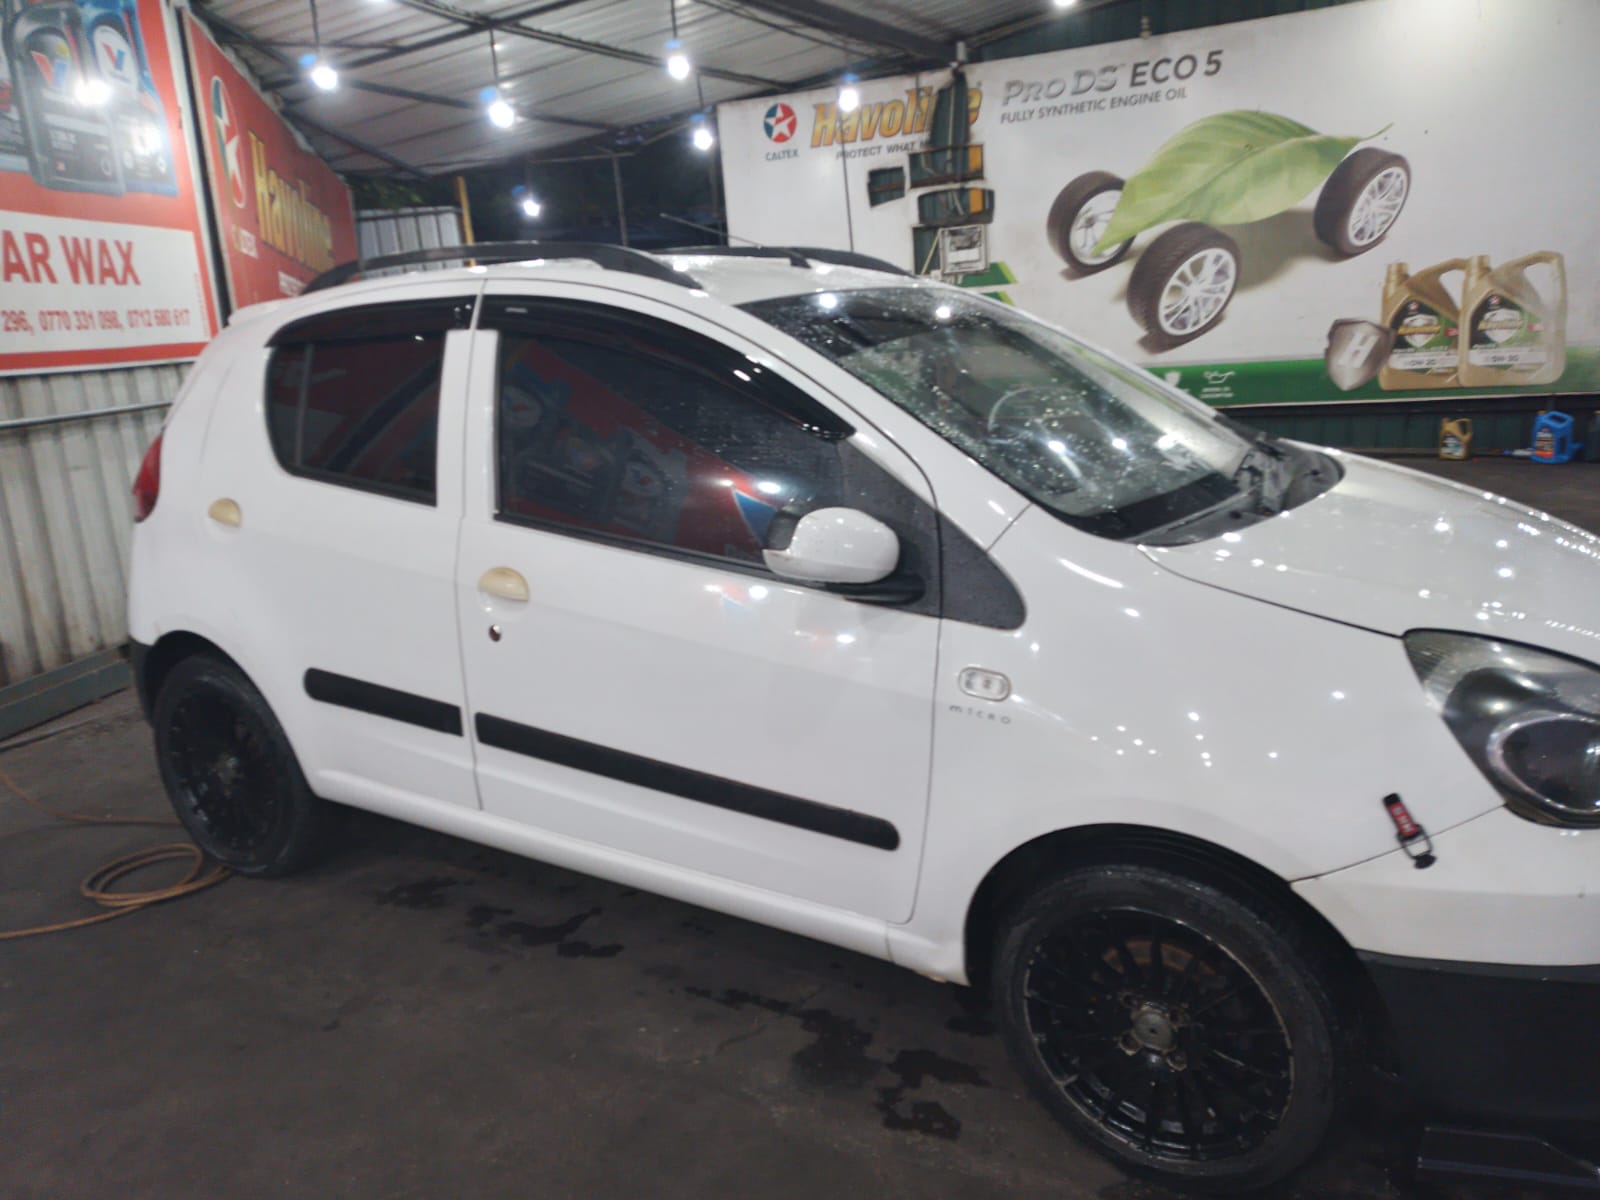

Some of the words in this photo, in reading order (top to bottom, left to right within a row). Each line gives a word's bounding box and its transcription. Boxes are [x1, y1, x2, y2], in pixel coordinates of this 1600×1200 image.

[1130, 54, 1198, 88] ECO
[1203, 49, 1224, 77] 5
[811, 86, 983, 148] Havolie
[1000, 109, 1035, 124] FULLY
[1038, 99, 1106, 119] SYNTHETIC
[1110, 91, 1161, 109] ENGINE
[1165, 87, 1188, 101] OIL
[765, 149, 798, 161] CALTEX
[836, 145, 881, 160] PROTECT
[886, 142, 916, 154] WHAT
[2, 230, 58, 284] AR
[58, 235, 141, 286] WAX
